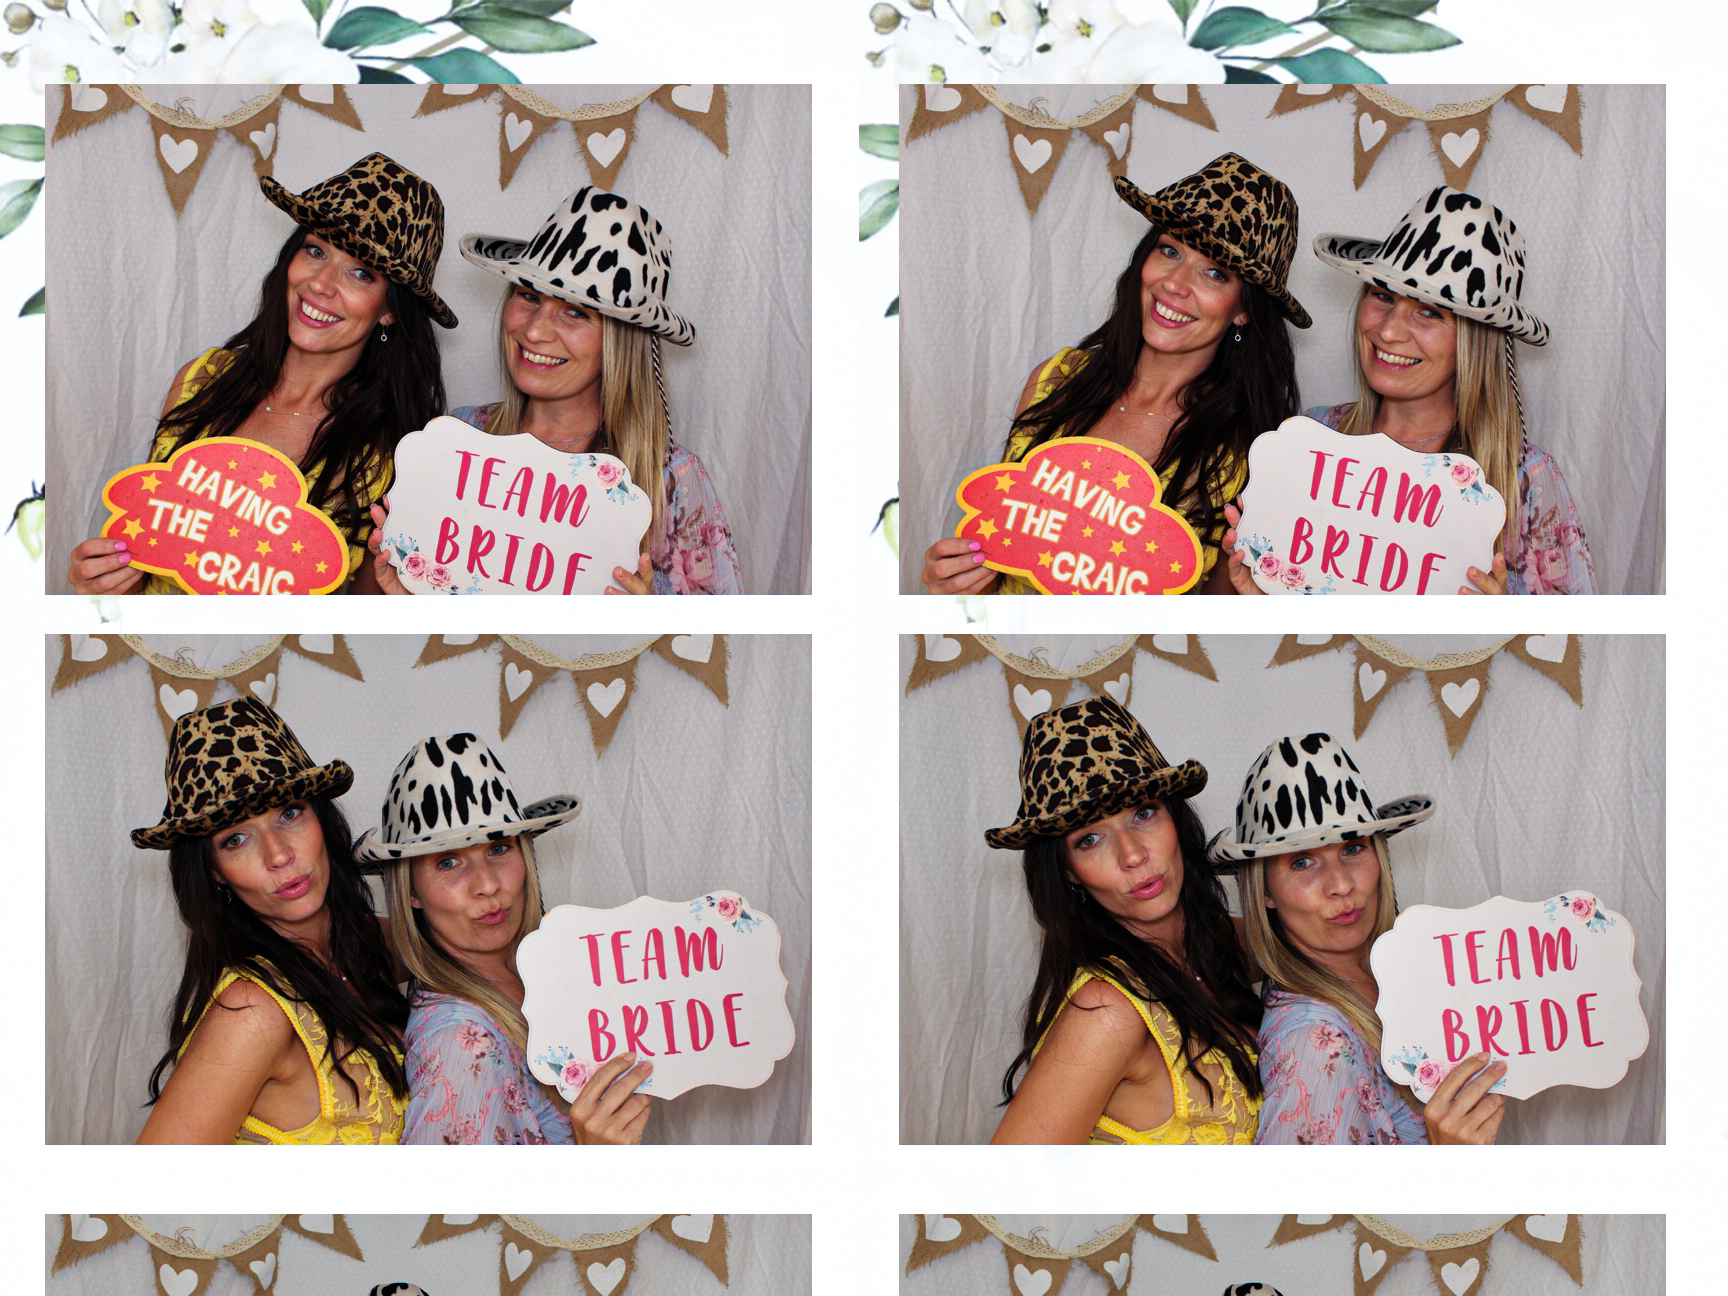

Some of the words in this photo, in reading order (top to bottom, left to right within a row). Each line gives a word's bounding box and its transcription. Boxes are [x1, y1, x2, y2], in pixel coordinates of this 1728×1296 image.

[147, 497, 214, 543] THE
[176, 457, 293, 536] HAVING
[455, 450, 590, 528] TEAM
[1001, 497, 1068, 543] THE
[1030, 457, 1147, 536] HAVING
[1309, 450, 1444, 528] TEAM
[197, 550, 295, 595] CRAIC
[1051, 550, 1149, 595] CRAIC
[579, 926, 723, 986] TEAM
[1433, 926, 1577, 986] TEAM
[588, 993, 750, 1062] BRIDE
[1442, 993, 1604, 1062] BRIDE
